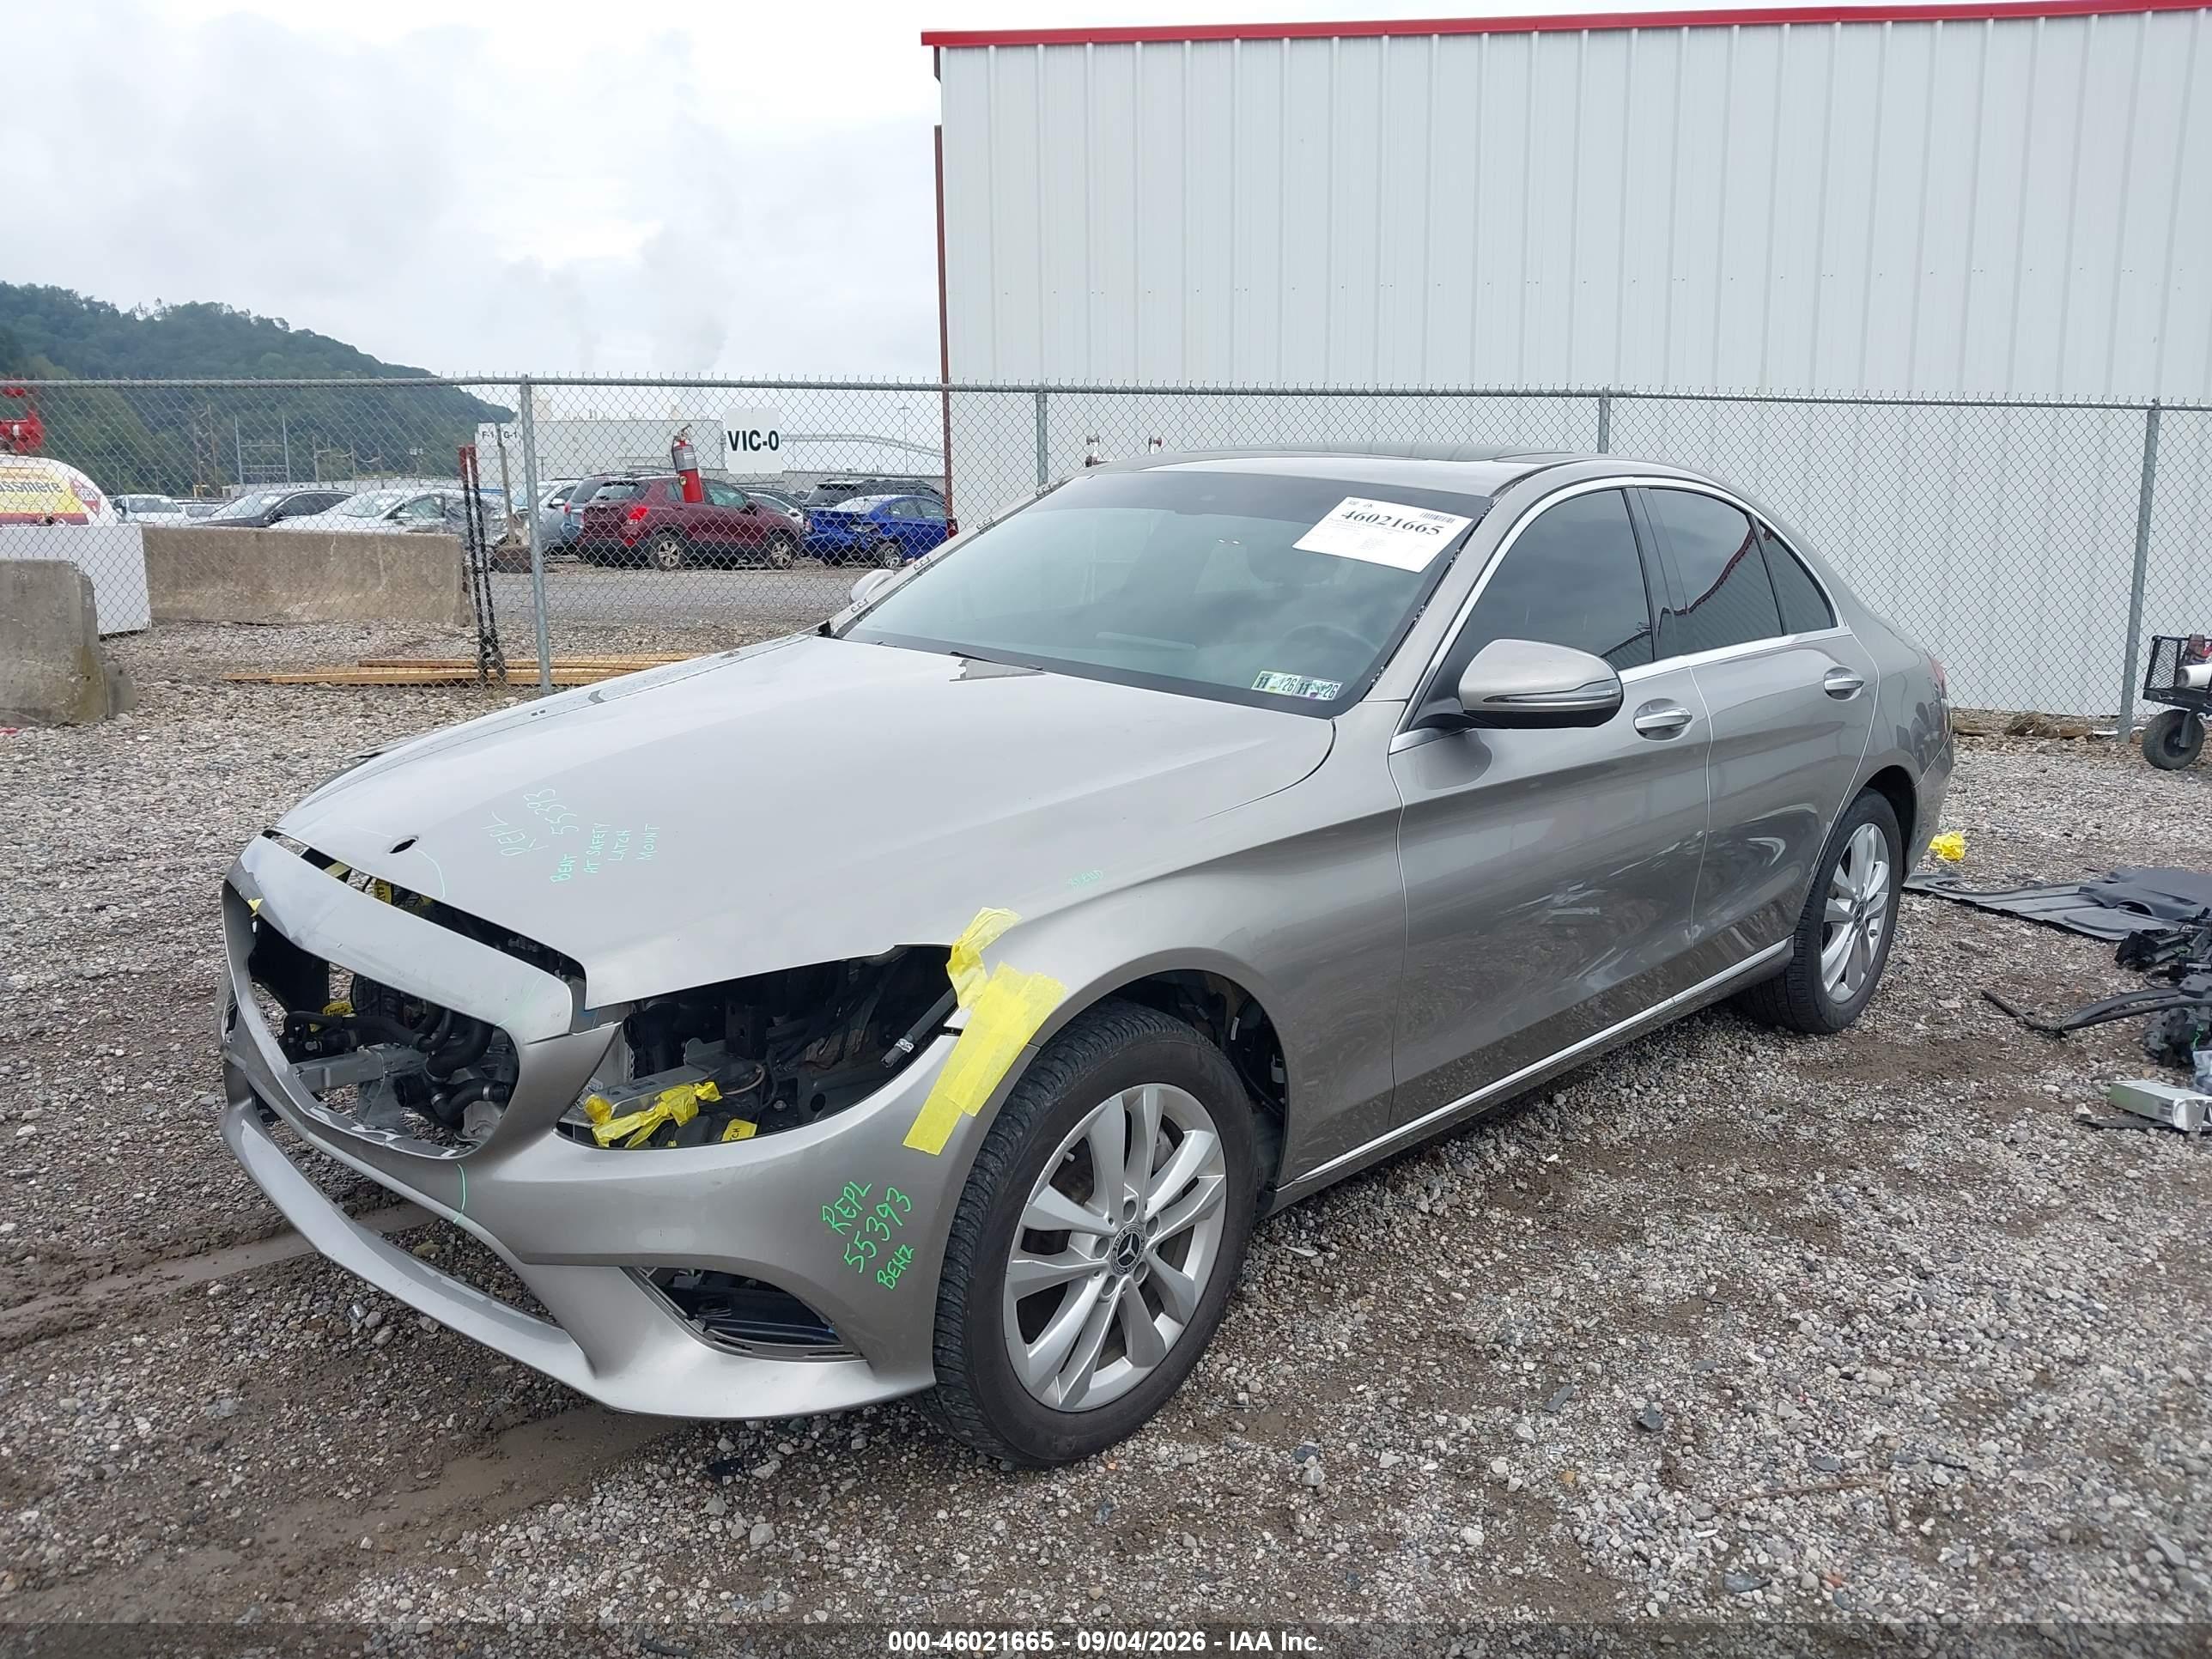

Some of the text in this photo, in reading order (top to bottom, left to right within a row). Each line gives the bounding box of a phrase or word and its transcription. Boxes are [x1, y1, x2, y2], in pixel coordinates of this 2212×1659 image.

[1341, 509, 1445, 536] 46021665
[1281, 677, 1297, 692] 26
[1323, 684, 1339, 699] 26
[584, 823, 612, 874] AT SAFETY
[608, 830, 633, 861] LATCH
[636, 823, 660, 860] MOUNT
[550, 854, 578, 883] BENT
[822, 1181, 872, 1236] REPL
[844, 1187, 912, 1273] 55393
[877, 1243, 915, 1290] BENZ
